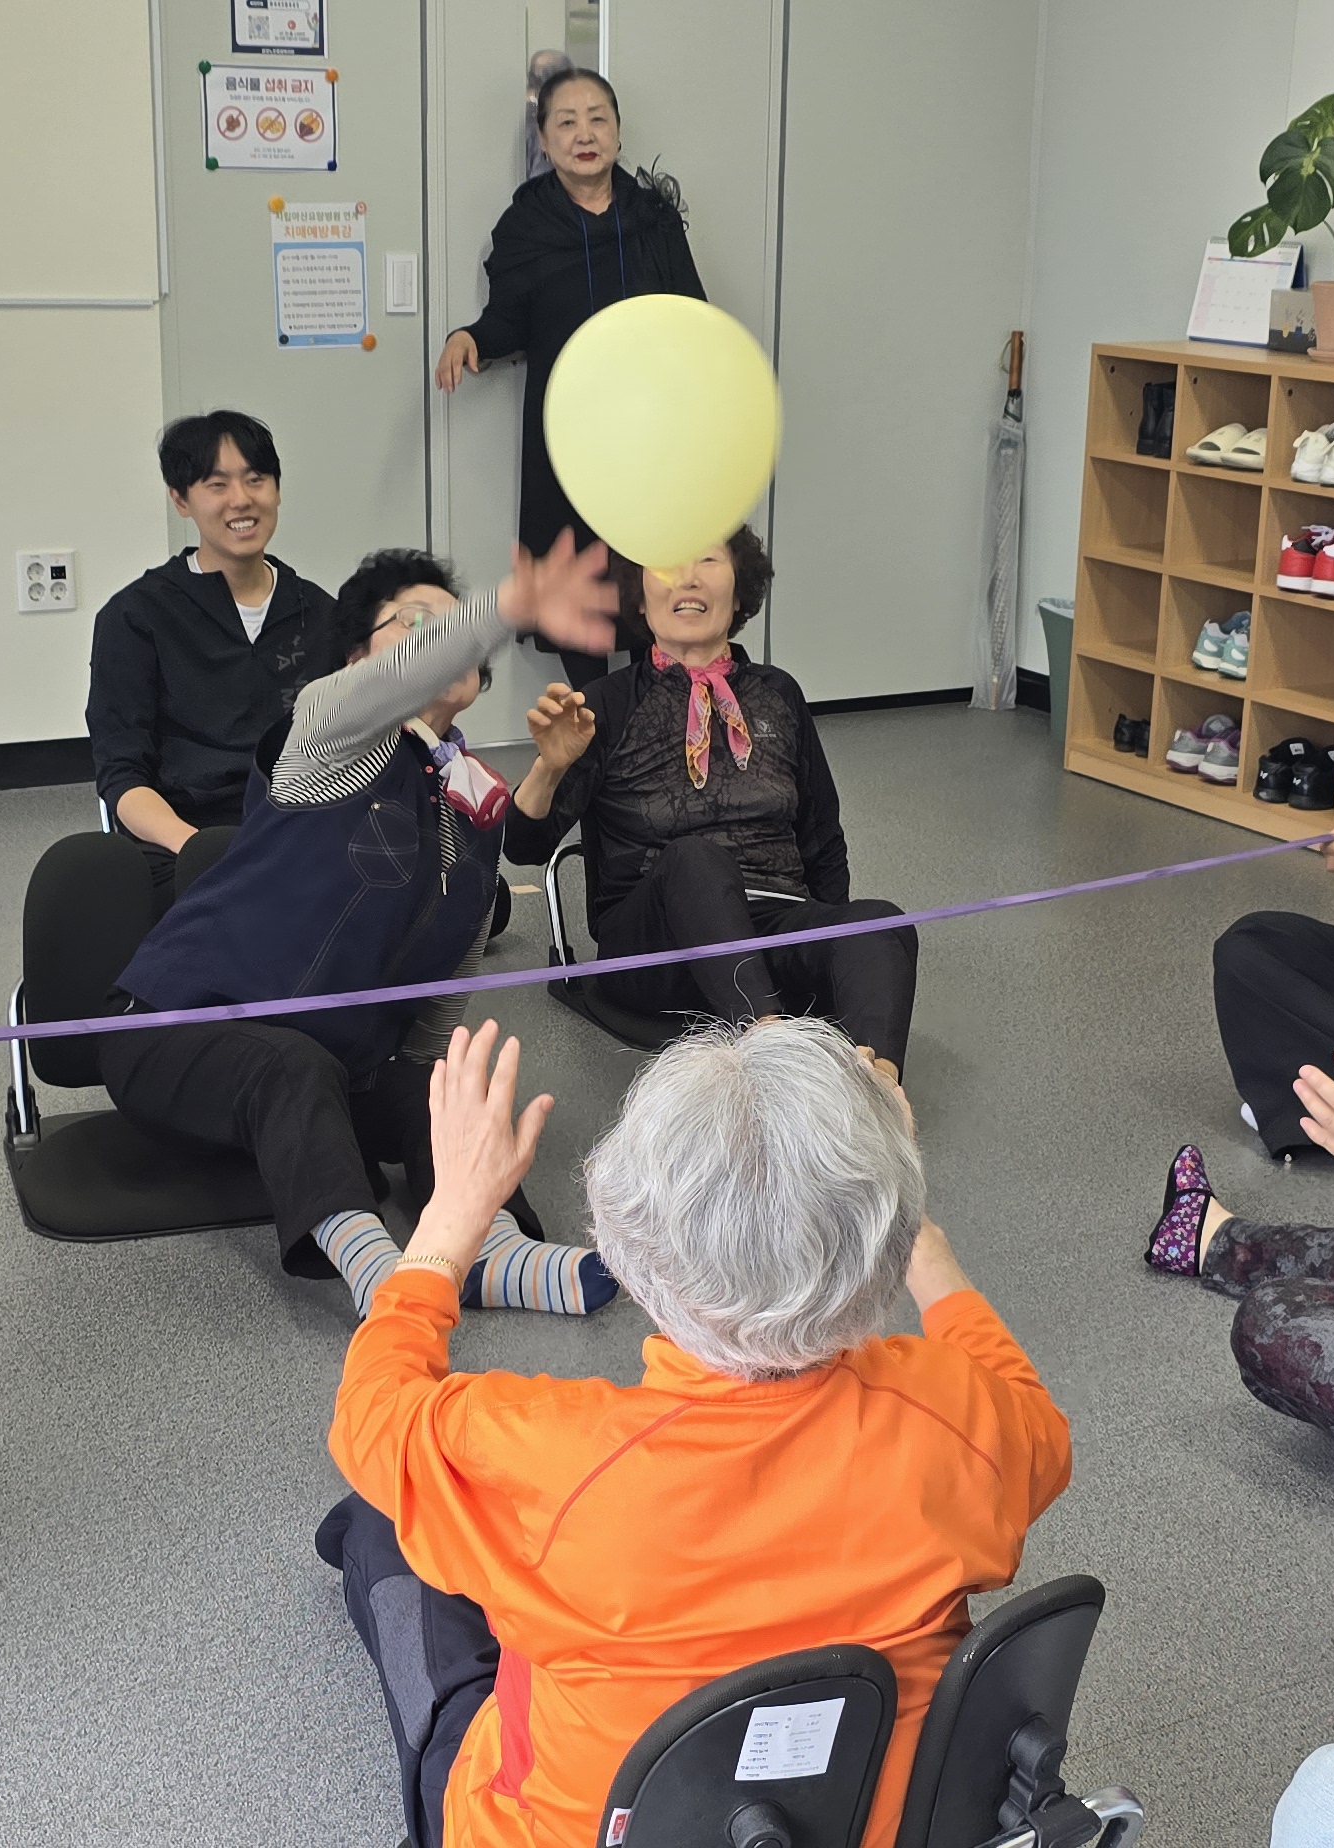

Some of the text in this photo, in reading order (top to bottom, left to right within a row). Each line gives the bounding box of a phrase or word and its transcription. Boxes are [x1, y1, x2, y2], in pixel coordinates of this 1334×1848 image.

[265, 77, 288, 94] 섭취
[291, 79, 314, 95] 금지
[284, 224, 352, 239] 치매예방특강
